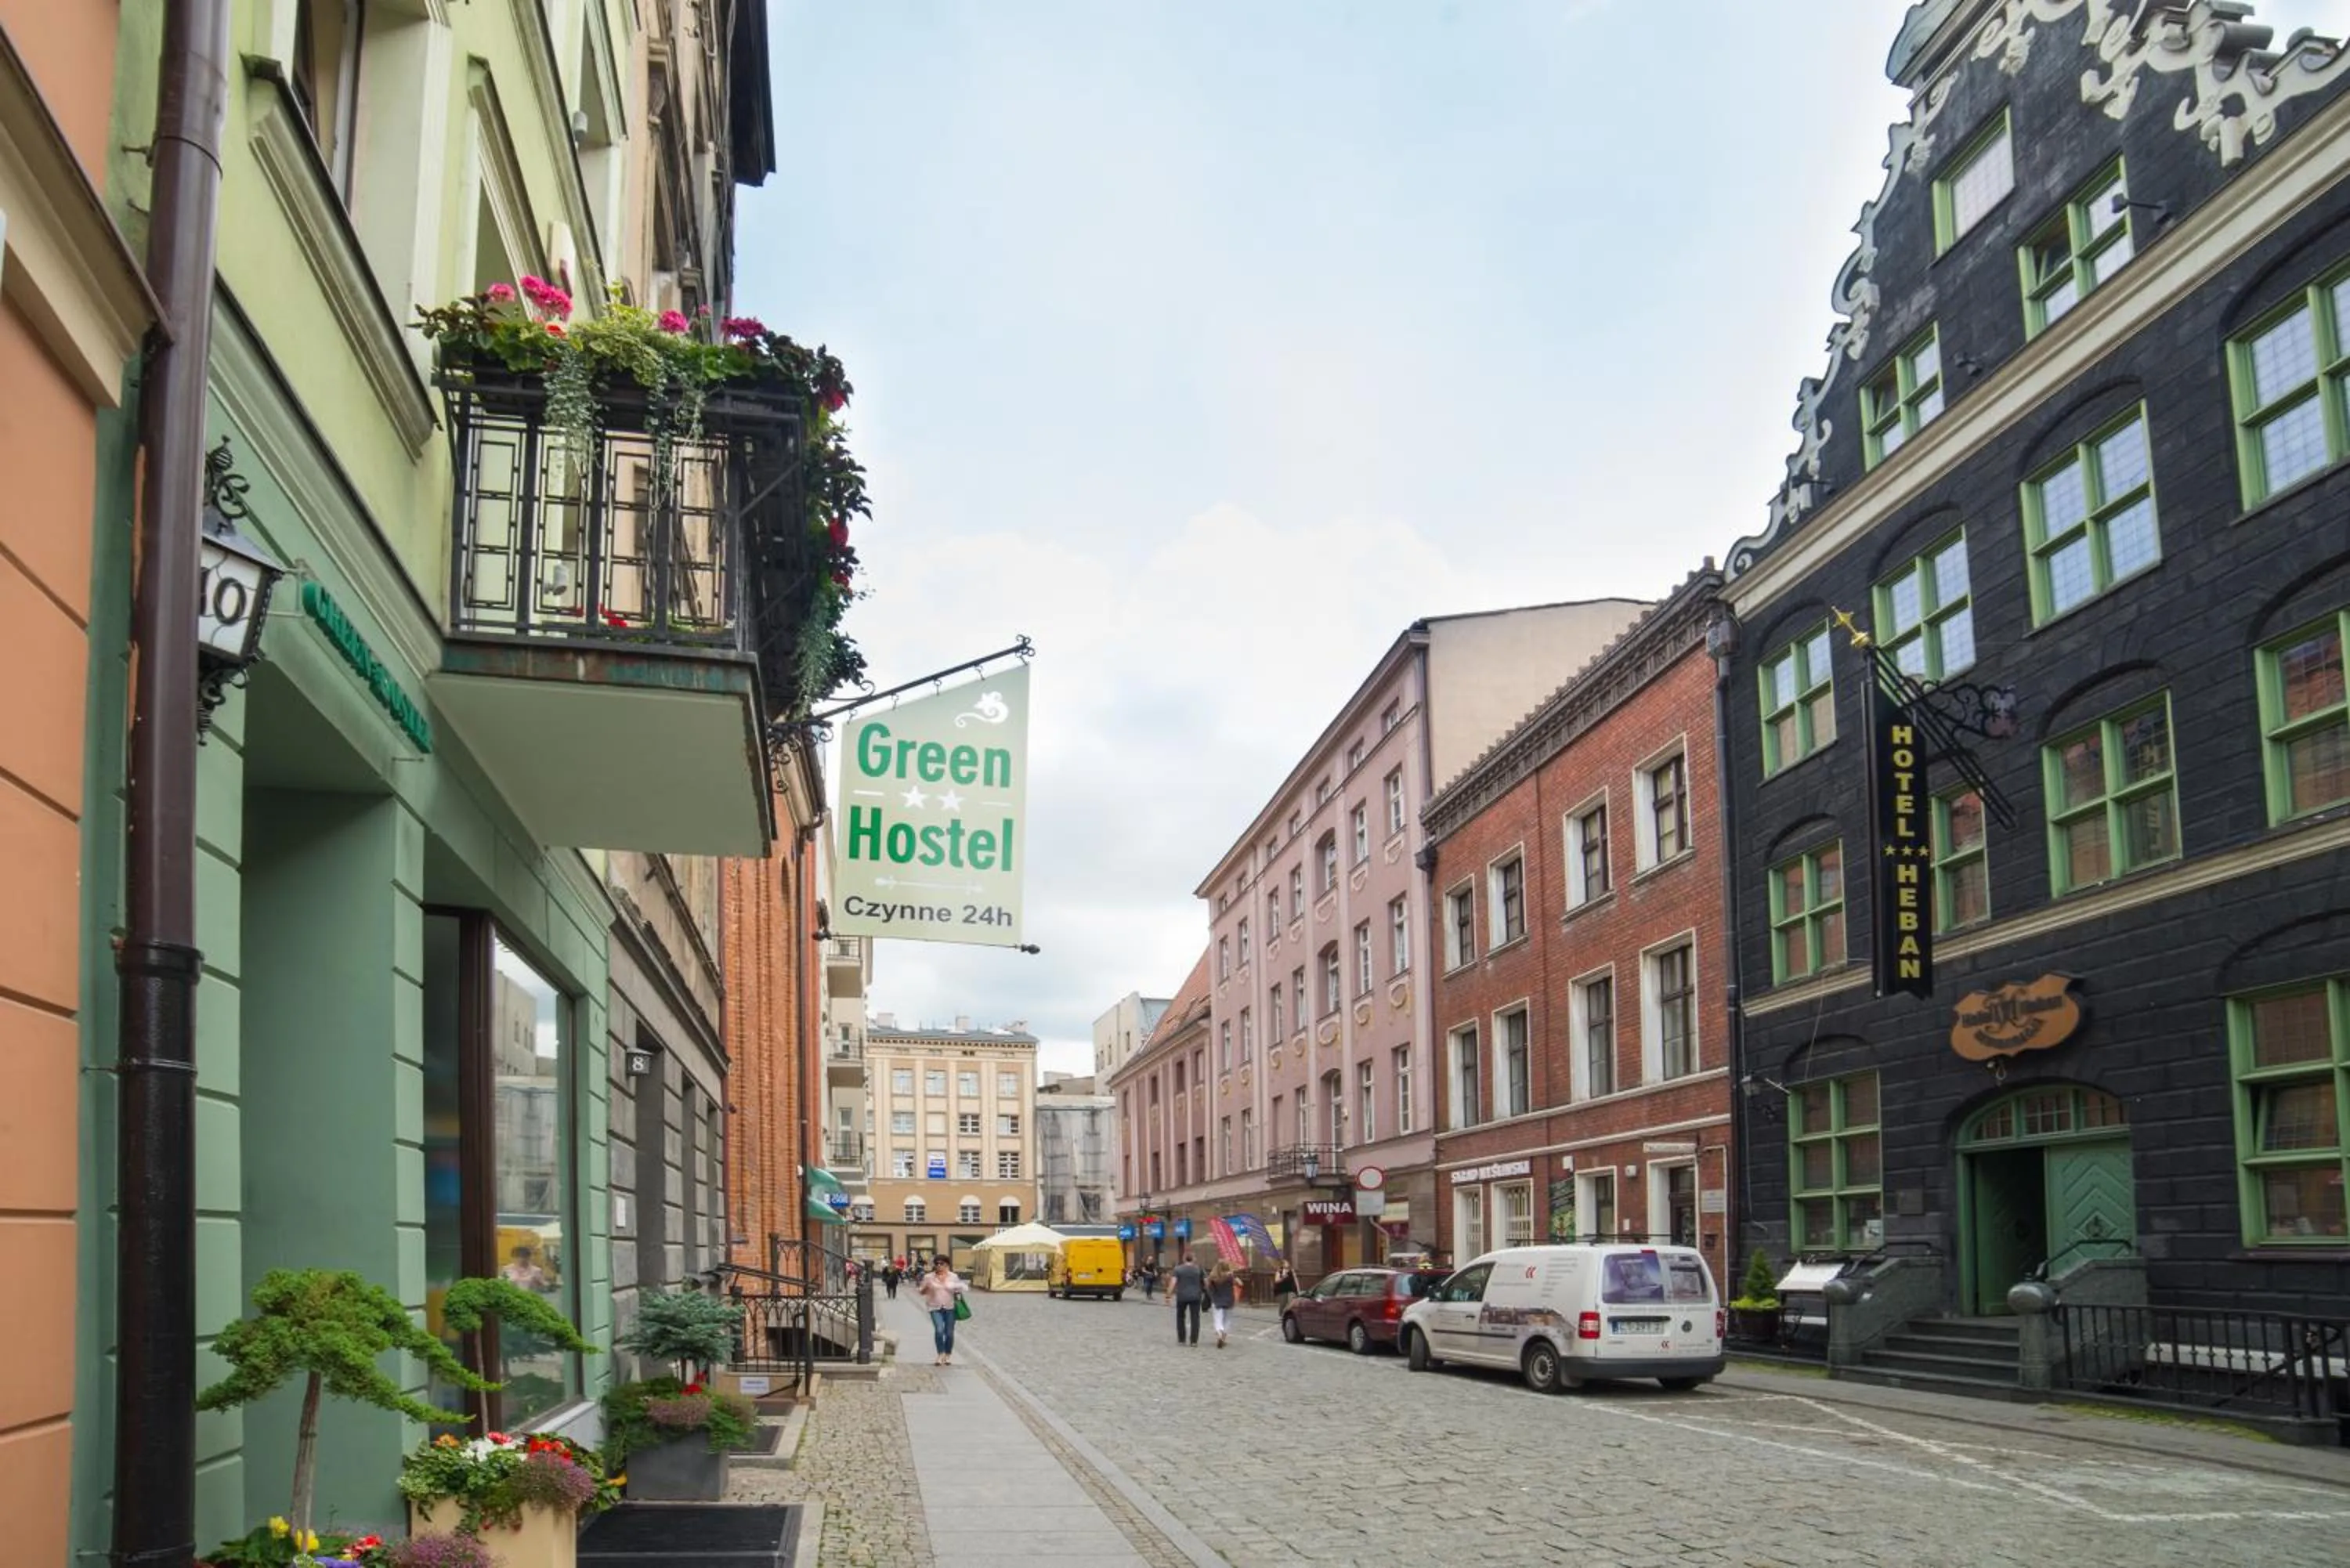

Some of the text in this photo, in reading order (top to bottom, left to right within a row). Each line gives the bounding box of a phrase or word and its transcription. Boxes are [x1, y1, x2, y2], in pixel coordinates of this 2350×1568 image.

[857, 722, 1011, 788] Green
[848, 805, 1014, 871] Hostel
[1891, 725, 1921, 979] HOTEL HEBAN
[844, 895, 1013, 926] Czynne 24h
[632, 1056, 643, 1071] 8
[1306, 1202, 1353, 1214] WINA
